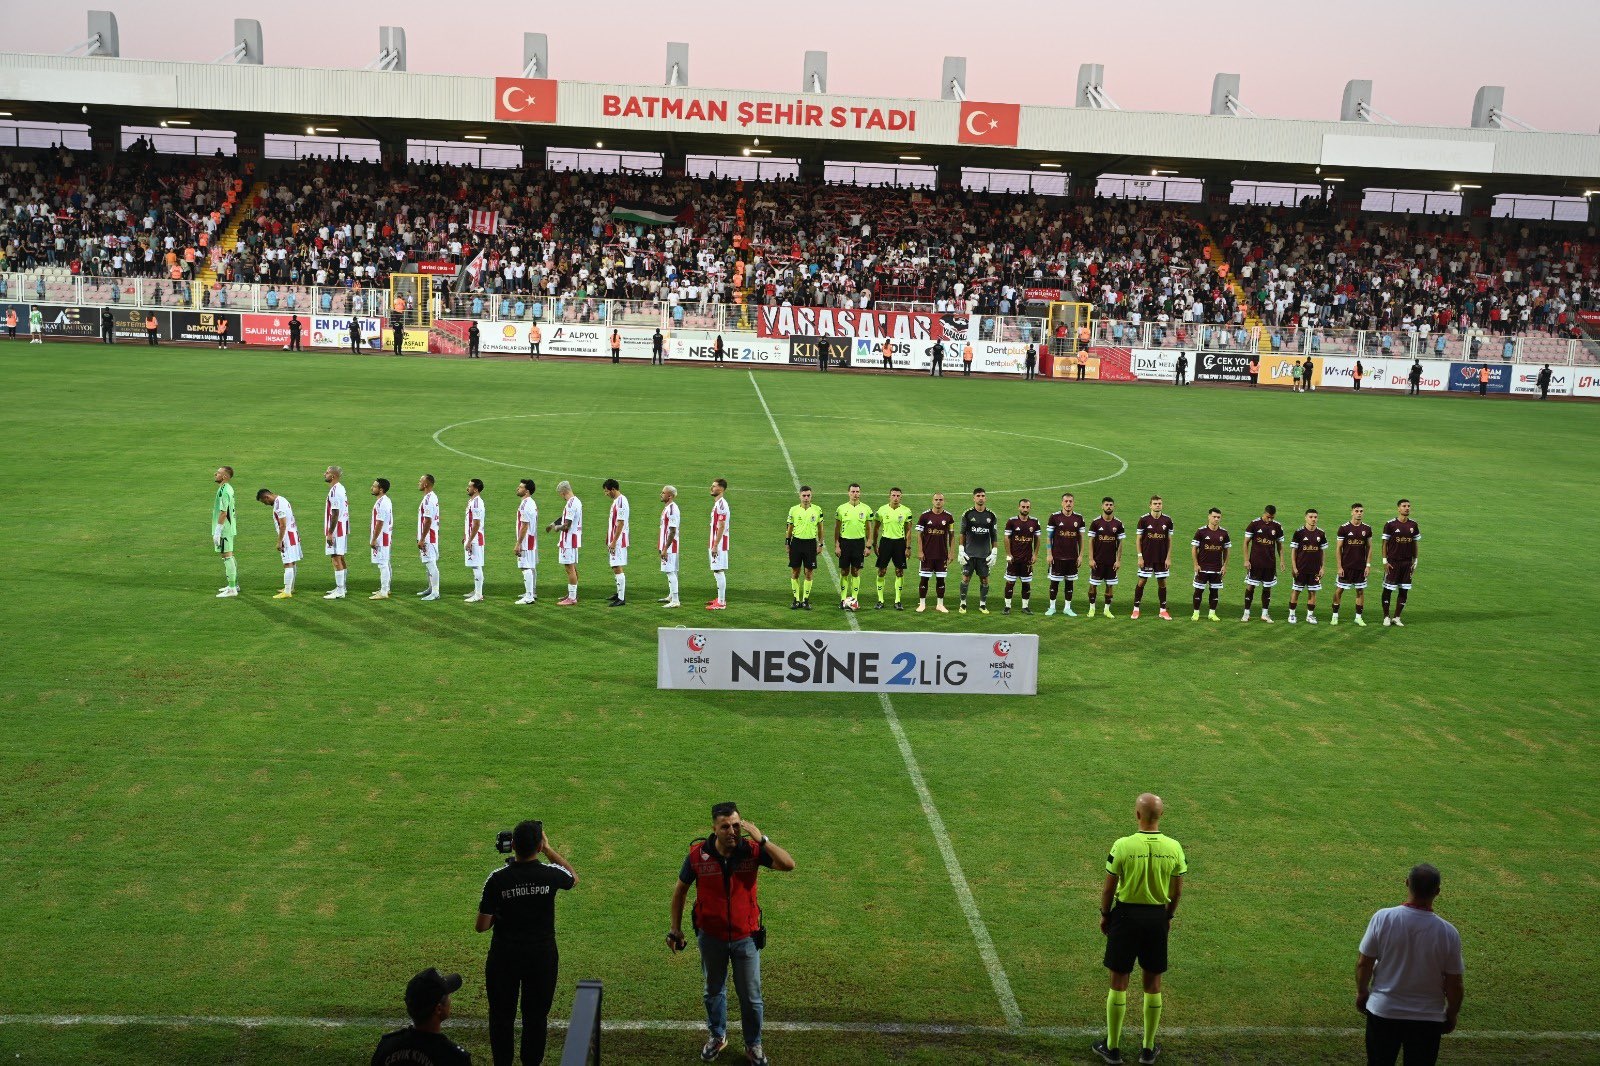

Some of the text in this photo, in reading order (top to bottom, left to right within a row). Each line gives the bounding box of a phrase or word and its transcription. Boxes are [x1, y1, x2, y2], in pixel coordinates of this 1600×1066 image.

[603, 94, 916, 131] BATMAN ŞEHİR STADI
[315, 318, 376, 331] EN PLATİK
[569, 331, 599, 340] ALPYOL
[689, 346, 739, 359] NESNE
[986, 345, 1025, 356] Dentplus
[985, 359, 1014, 367] Dentplus
[1137, 359, 1157, 368] DM
[731, 638, 879, 685] NESİNE
[501, 885, 550, 899] PETROLSPOR
